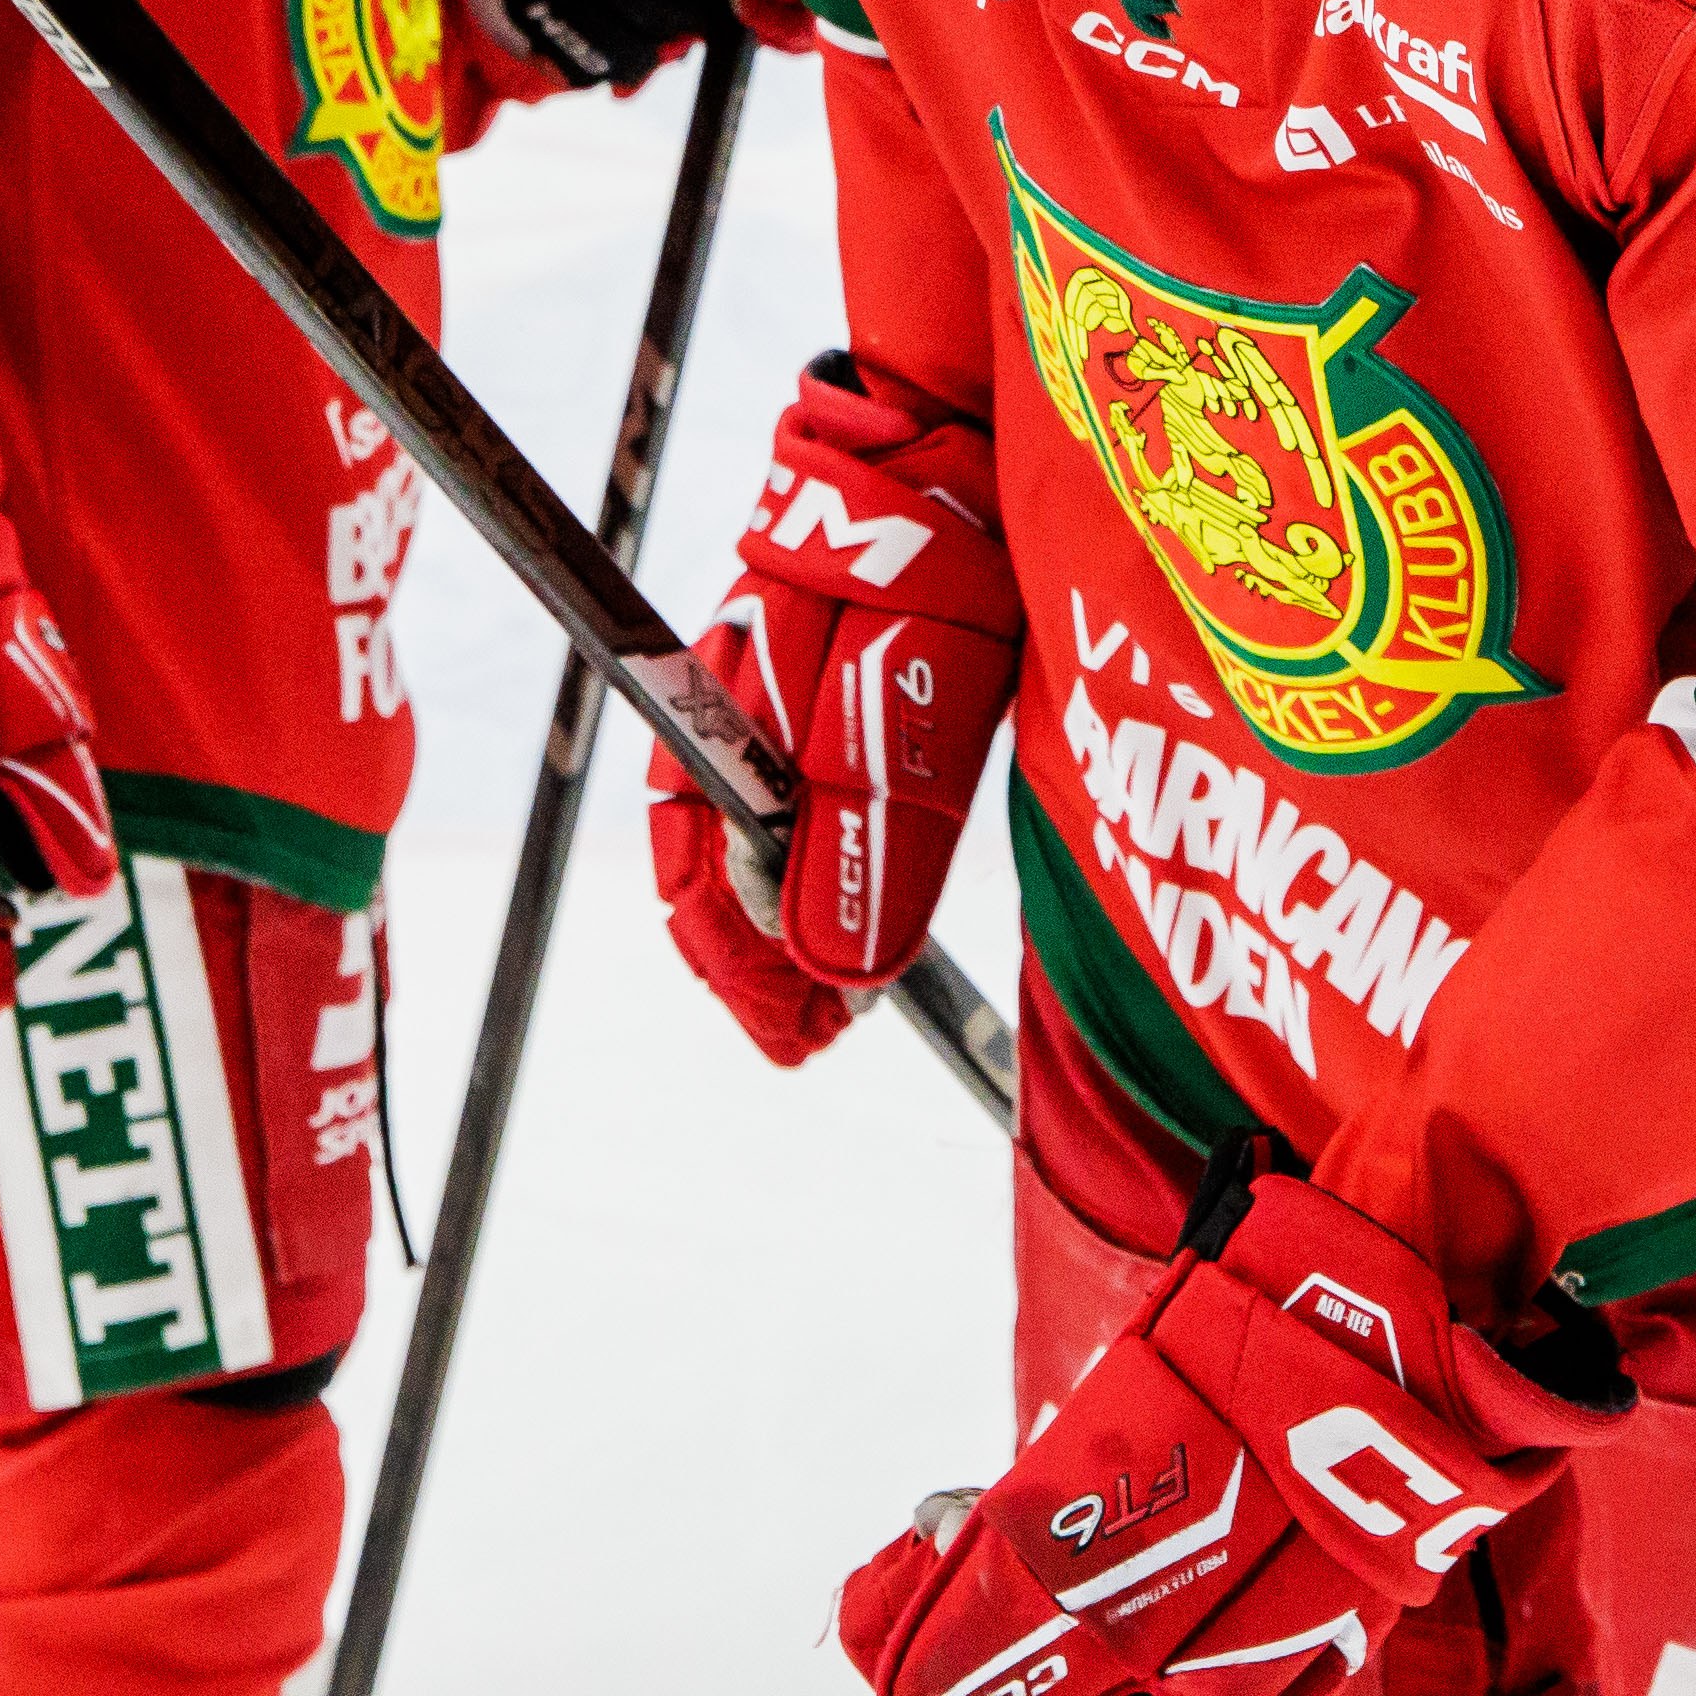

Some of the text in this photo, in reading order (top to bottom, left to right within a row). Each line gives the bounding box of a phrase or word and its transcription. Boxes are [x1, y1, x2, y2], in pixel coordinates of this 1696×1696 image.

[1070, 11, 1241, 108] CCM
[1370, 441, 1471, 659] KLUBB
[837, 808, 864, 934] CCM
[1050, 1443, 1190, 1557] FT6
